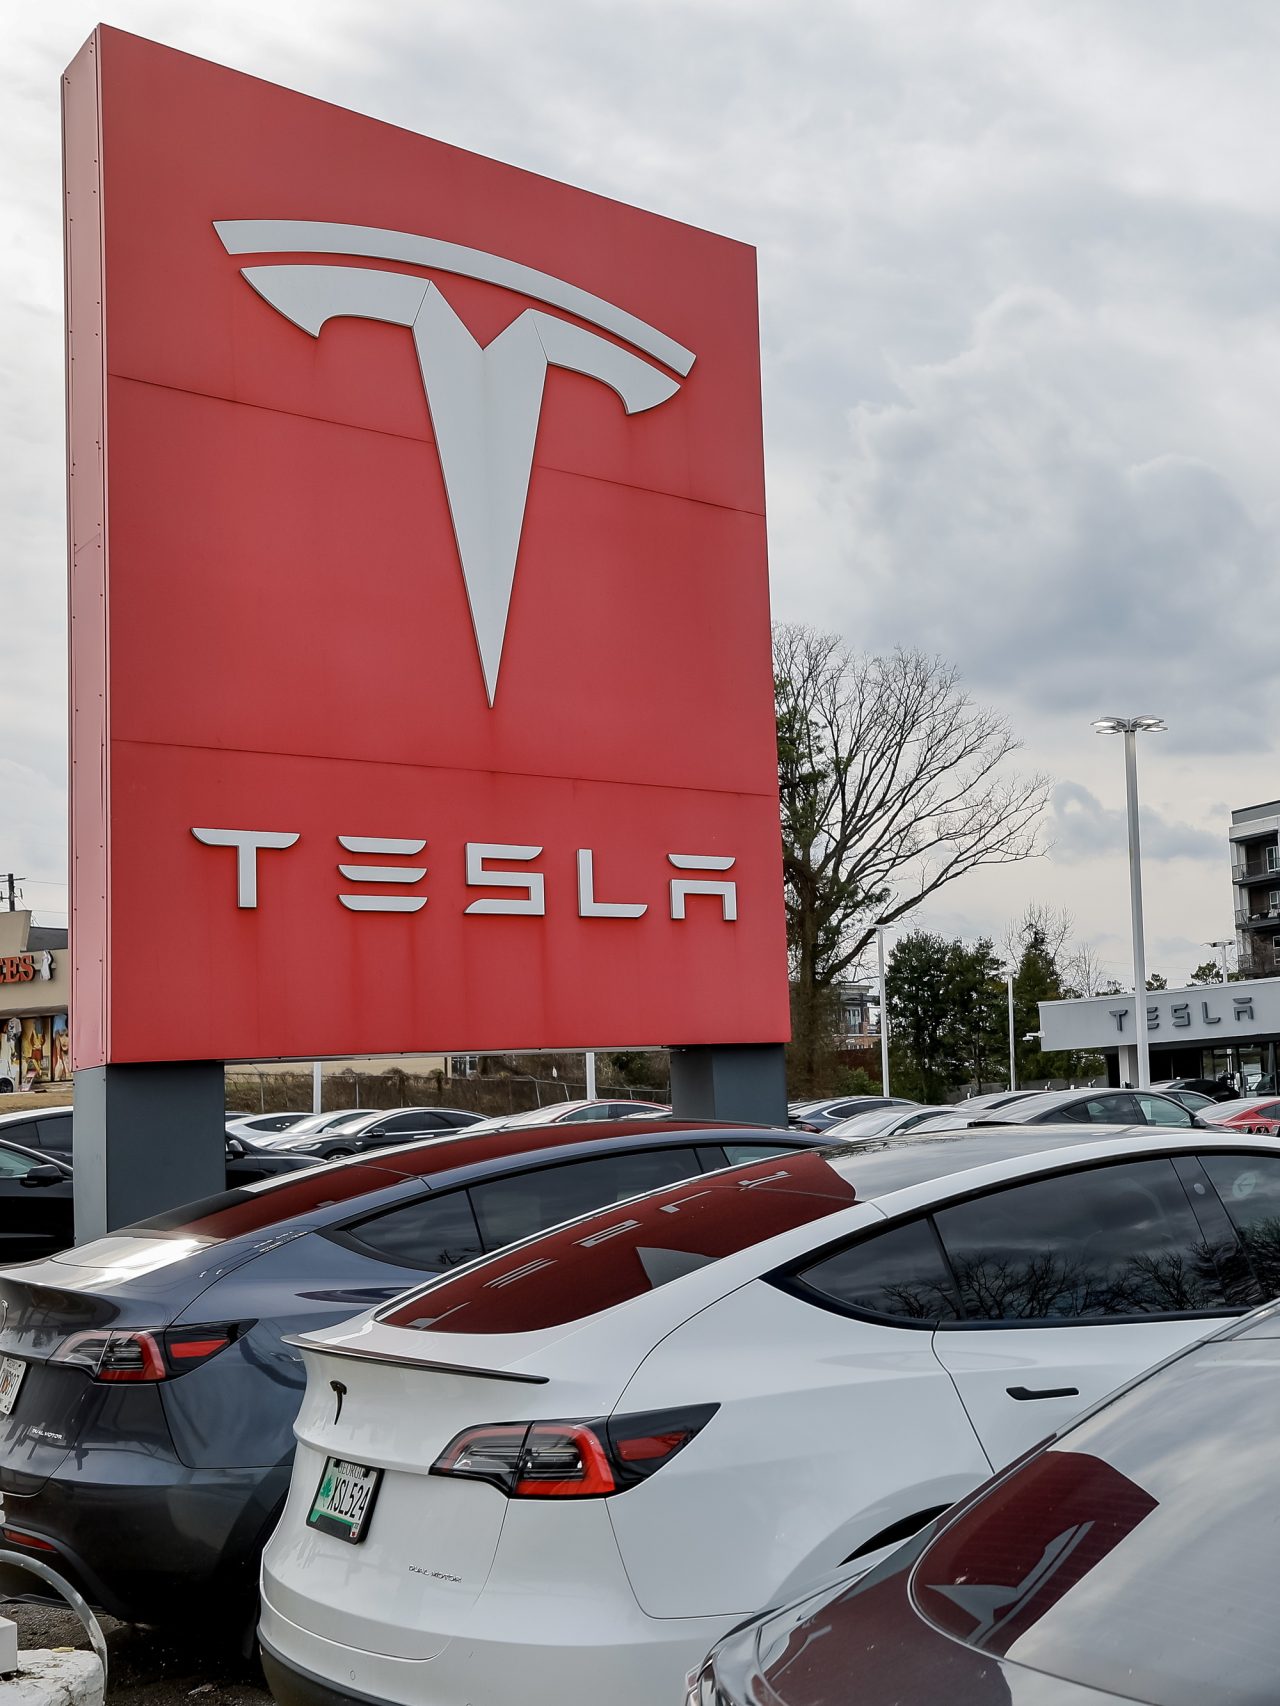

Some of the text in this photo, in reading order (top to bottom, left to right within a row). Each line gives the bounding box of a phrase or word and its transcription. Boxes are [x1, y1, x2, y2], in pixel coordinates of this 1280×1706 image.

[190, 826, 737, 922] TESLA
[1108, 997, 1255, 1032] TESLA
[326, 1476, 371, 1521] XSL524
